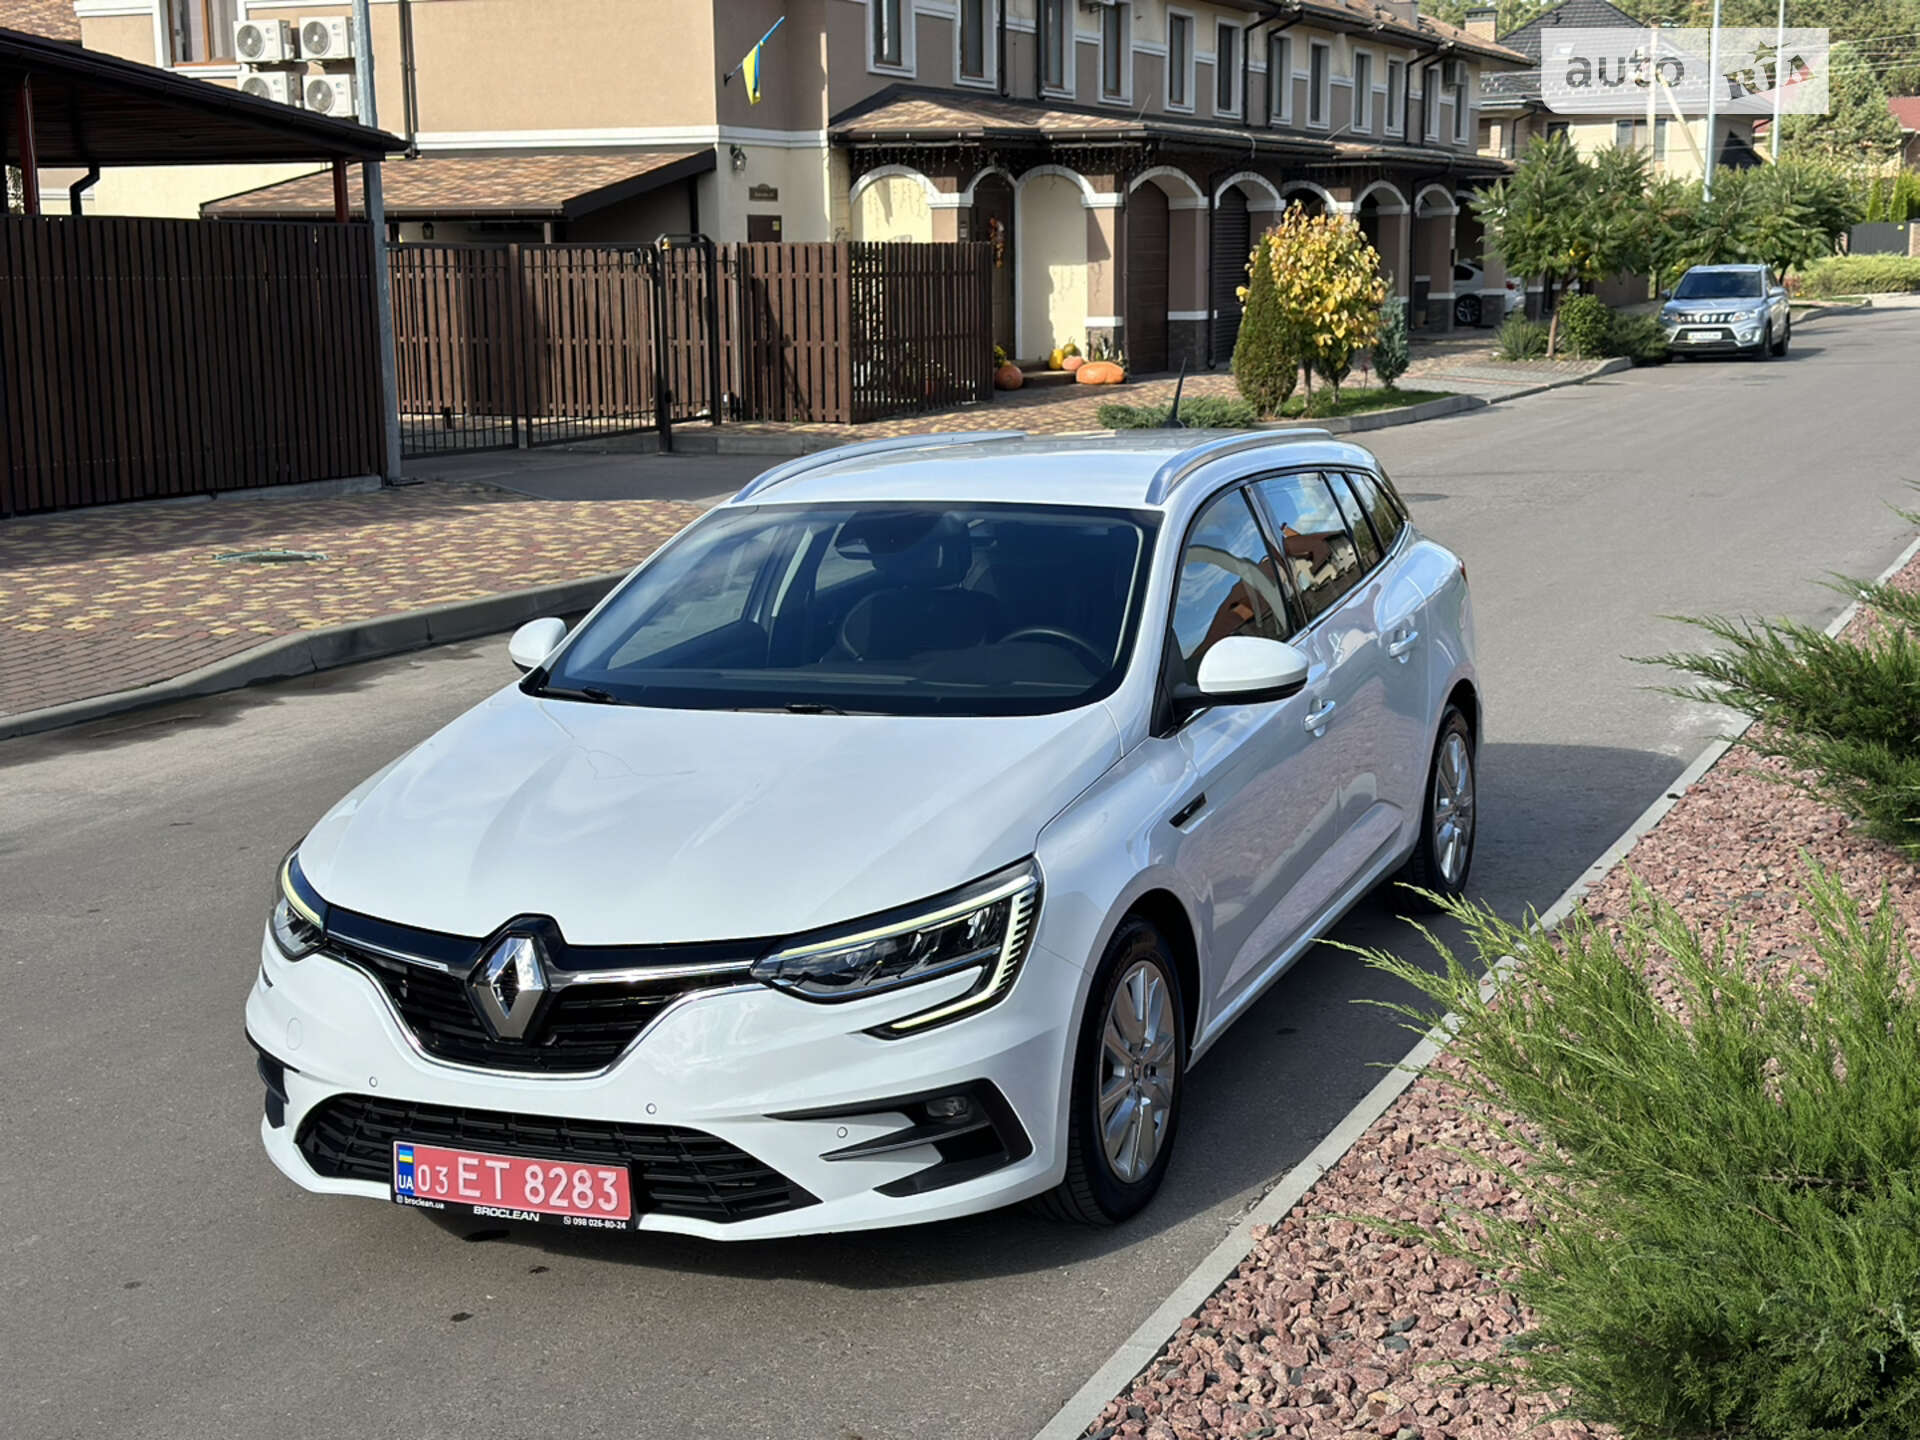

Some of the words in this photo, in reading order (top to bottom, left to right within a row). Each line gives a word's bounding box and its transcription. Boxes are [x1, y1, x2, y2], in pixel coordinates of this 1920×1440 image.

[399, 1174, 414, 1190] UA
[418, 1165, 448, 1194] 03
[458, 1157, 509, 1200] ET
[524, 1165, 617, 1211] 8283
[473, 1206, 539, 1222] BROCLEAN
